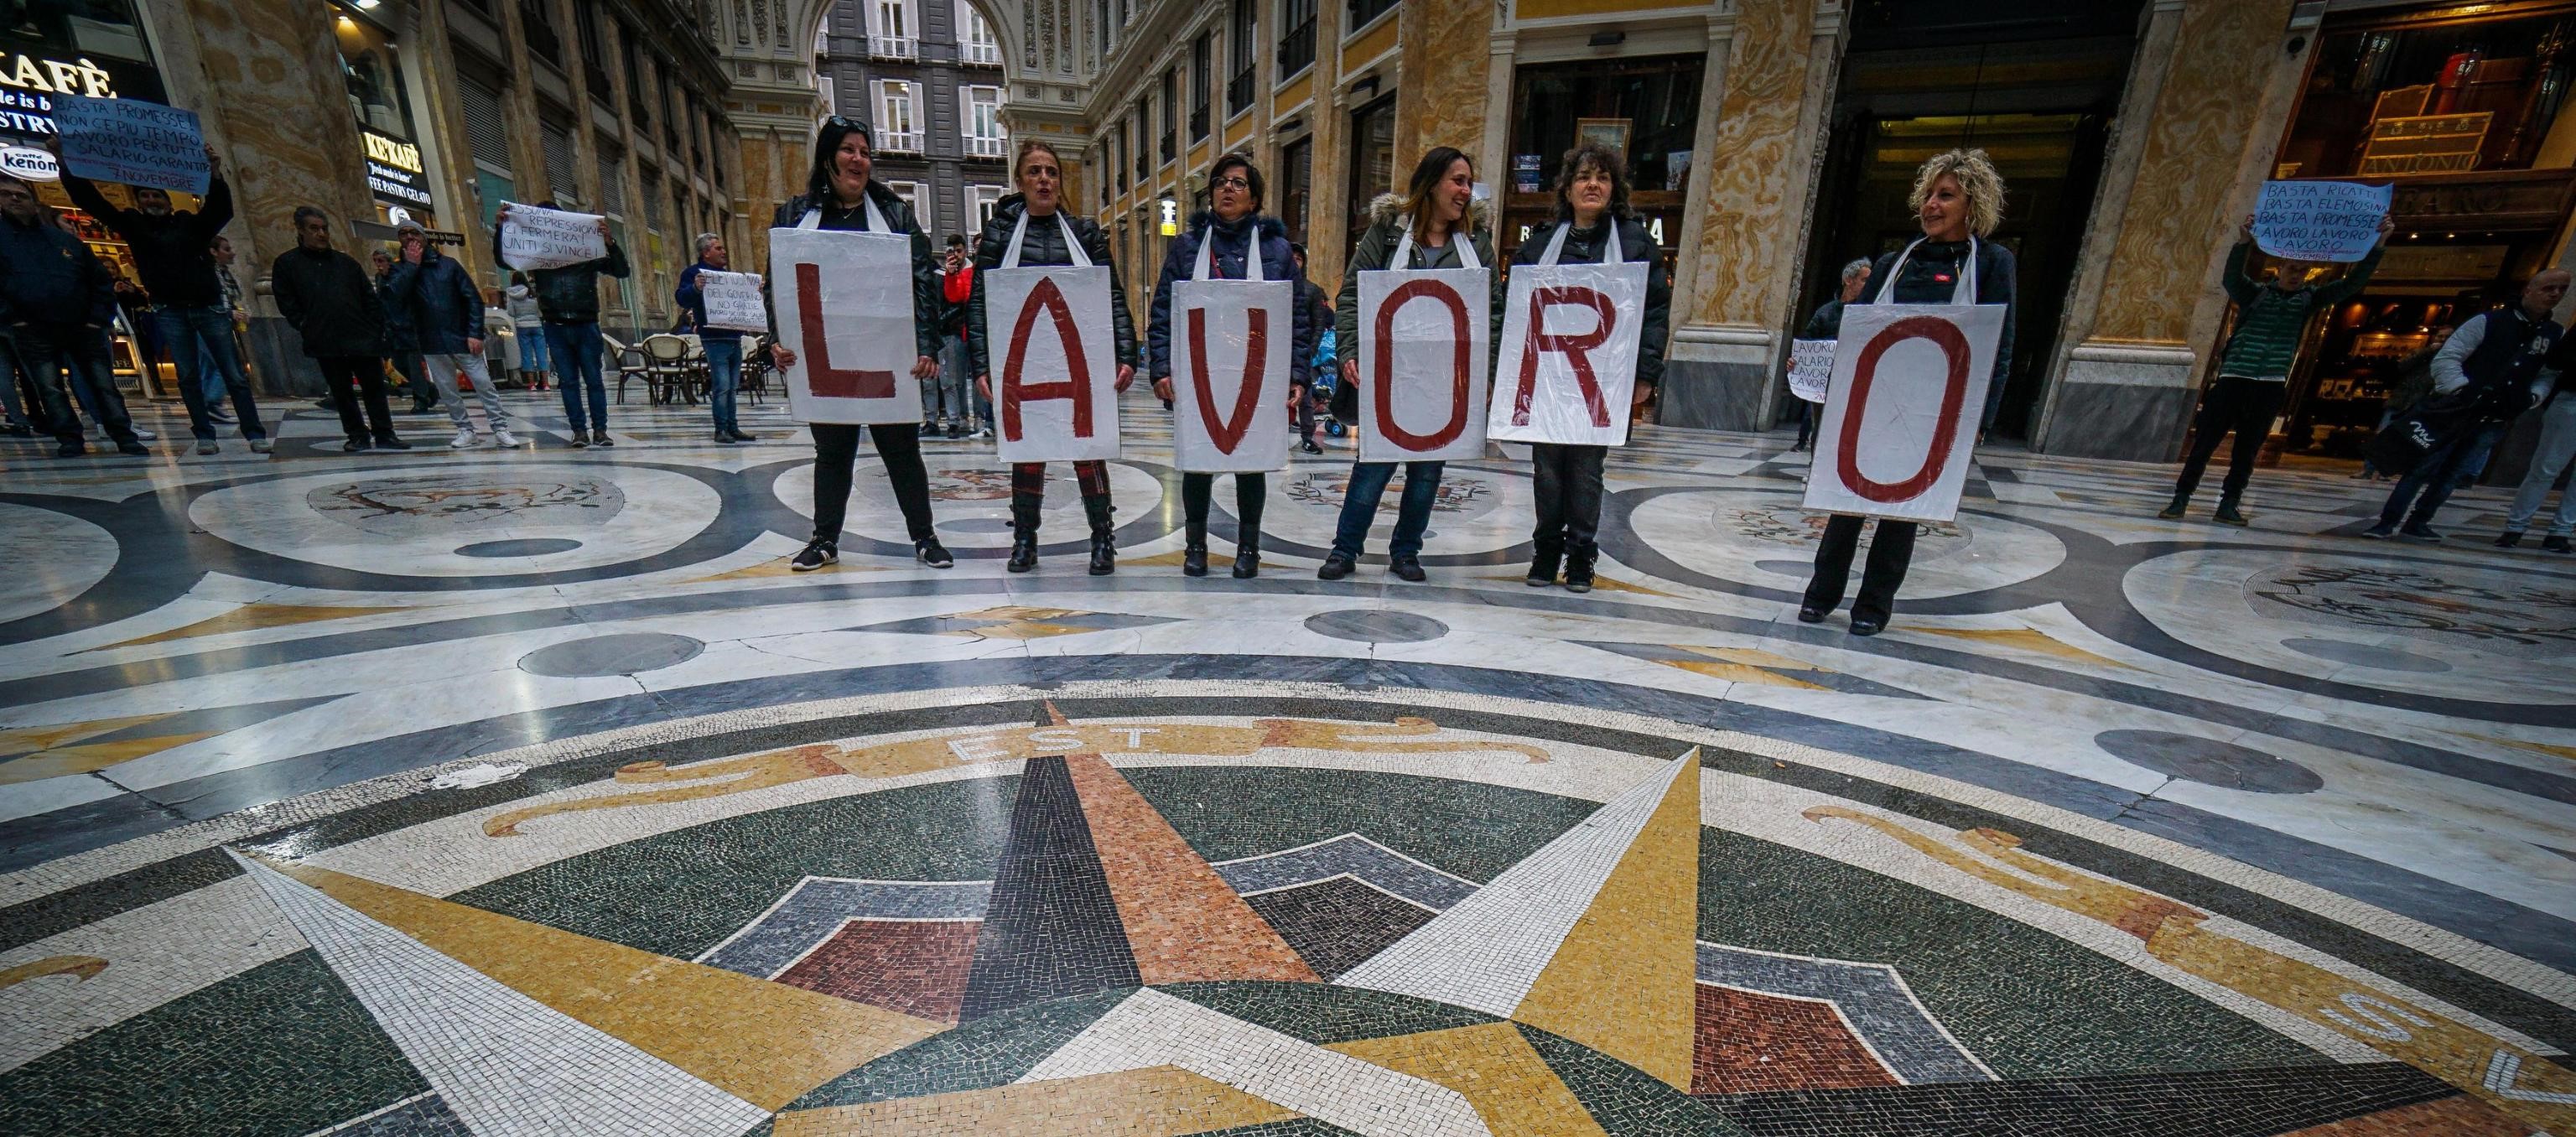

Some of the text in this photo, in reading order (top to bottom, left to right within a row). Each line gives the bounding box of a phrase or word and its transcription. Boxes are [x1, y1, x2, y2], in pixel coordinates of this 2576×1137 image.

[20, 92, 35, 109] is
[54, 96, 109, 115] BASTA
[117, 103, 195, 132] PROMESSE!
[60, 114, 87, 127] NON
[142, 126, 200, 147] TEMPO
[60, 127, 202, 158] LAVORO PER TUTTI
[79, 143, 148, 164] SALARIO
[3, 153, 58, 172] kenon
[381, 180, 407, 198] PASTRY
[406, 187, 431, 205] GELATO
[2267, 184, 2377, 200] BASTA RICATTI
[509, 205, 554, 216] ESSUNA
[2265, 199, 2390, 213] BASTA ELEMOSINA
[529, 215, 605, 236] REPRESSIONE
[2258, 211, 2380, 229] BASTA PROMESSE
[504, 225, 516, 235] CI
[2312, 227, 2369, 241] LAVORO
[503, 236, 538, 251] UNITI
[542, 241, 553, 253] SI
[2273, 239, 2344, 250] LAVORO
[1793, 341, 1836, 354] LAVORO
[1792, 366, 1829, 379] LAVOR
[1789, 376, 1826, 388] LAVOR
[948, 728, 1161, 761] EST
